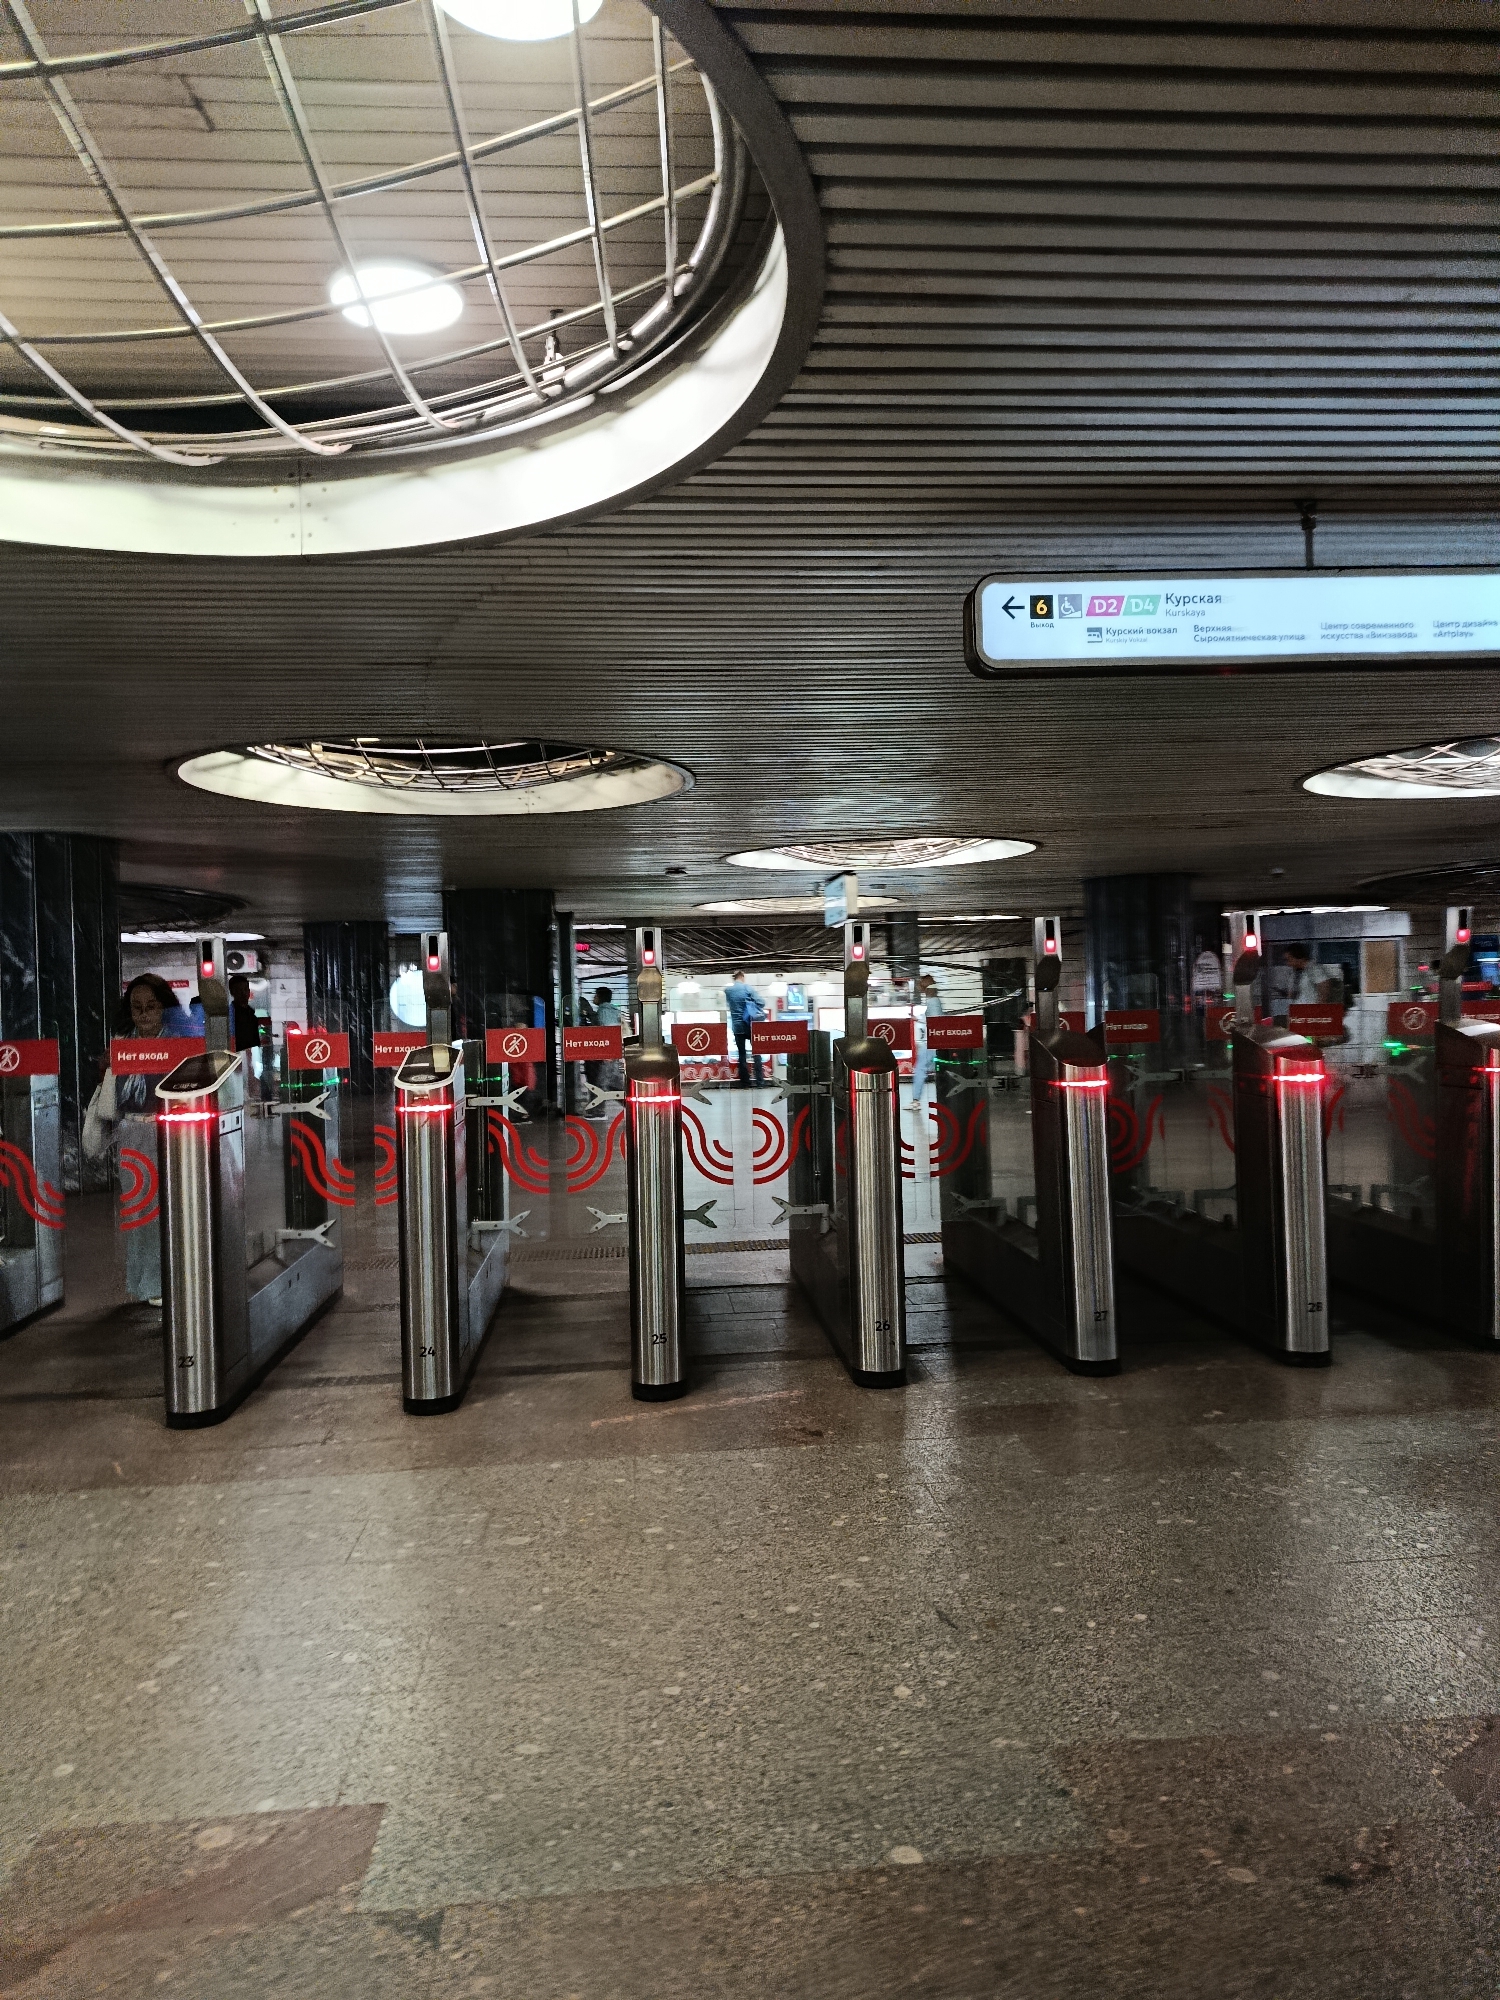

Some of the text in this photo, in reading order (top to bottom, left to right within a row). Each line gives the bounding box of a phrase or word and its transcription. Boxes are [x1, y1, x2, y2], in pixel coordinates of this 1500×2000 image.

[1094, 597, 1155, 613] D2 D4
[1165, 593, 1222, 607] Курская
[1036, 599, 1048, 615] 6
[1165, 608, 1206, 618] Kurskaya
[1030, 621, 1055, 629] Выход
[1193, 624, 1232, 634] Верхняя
[1320, 621, 1415, 631] Центр современного
[1432, 620, 1460, 629] Центр
[1105, 626, 1178, 637] Курский вокзал
[1320, 632, 1364, 641] искусства
[1193, 633, 1306, 643] Сыромятническая улица
[928, 1028, 973, 1037] Нет входа
[753, 1034, 770, 1042] Нет
[565, 1039, 610, 1048] Нет входа
[375, 1045, 392, 1054] Нет
[117, 1051, 169, 1062] Нет входа
[1307, 1301, 1323, 1313] 28
[1094, 1310, 1108, 1322] 27
[875, 1320, 891, 1332] 26
[651, 1332, 668, 1345] 25
[419, 1346, 436, 1358] 24
[178, 1355, 195, 1369] 23
